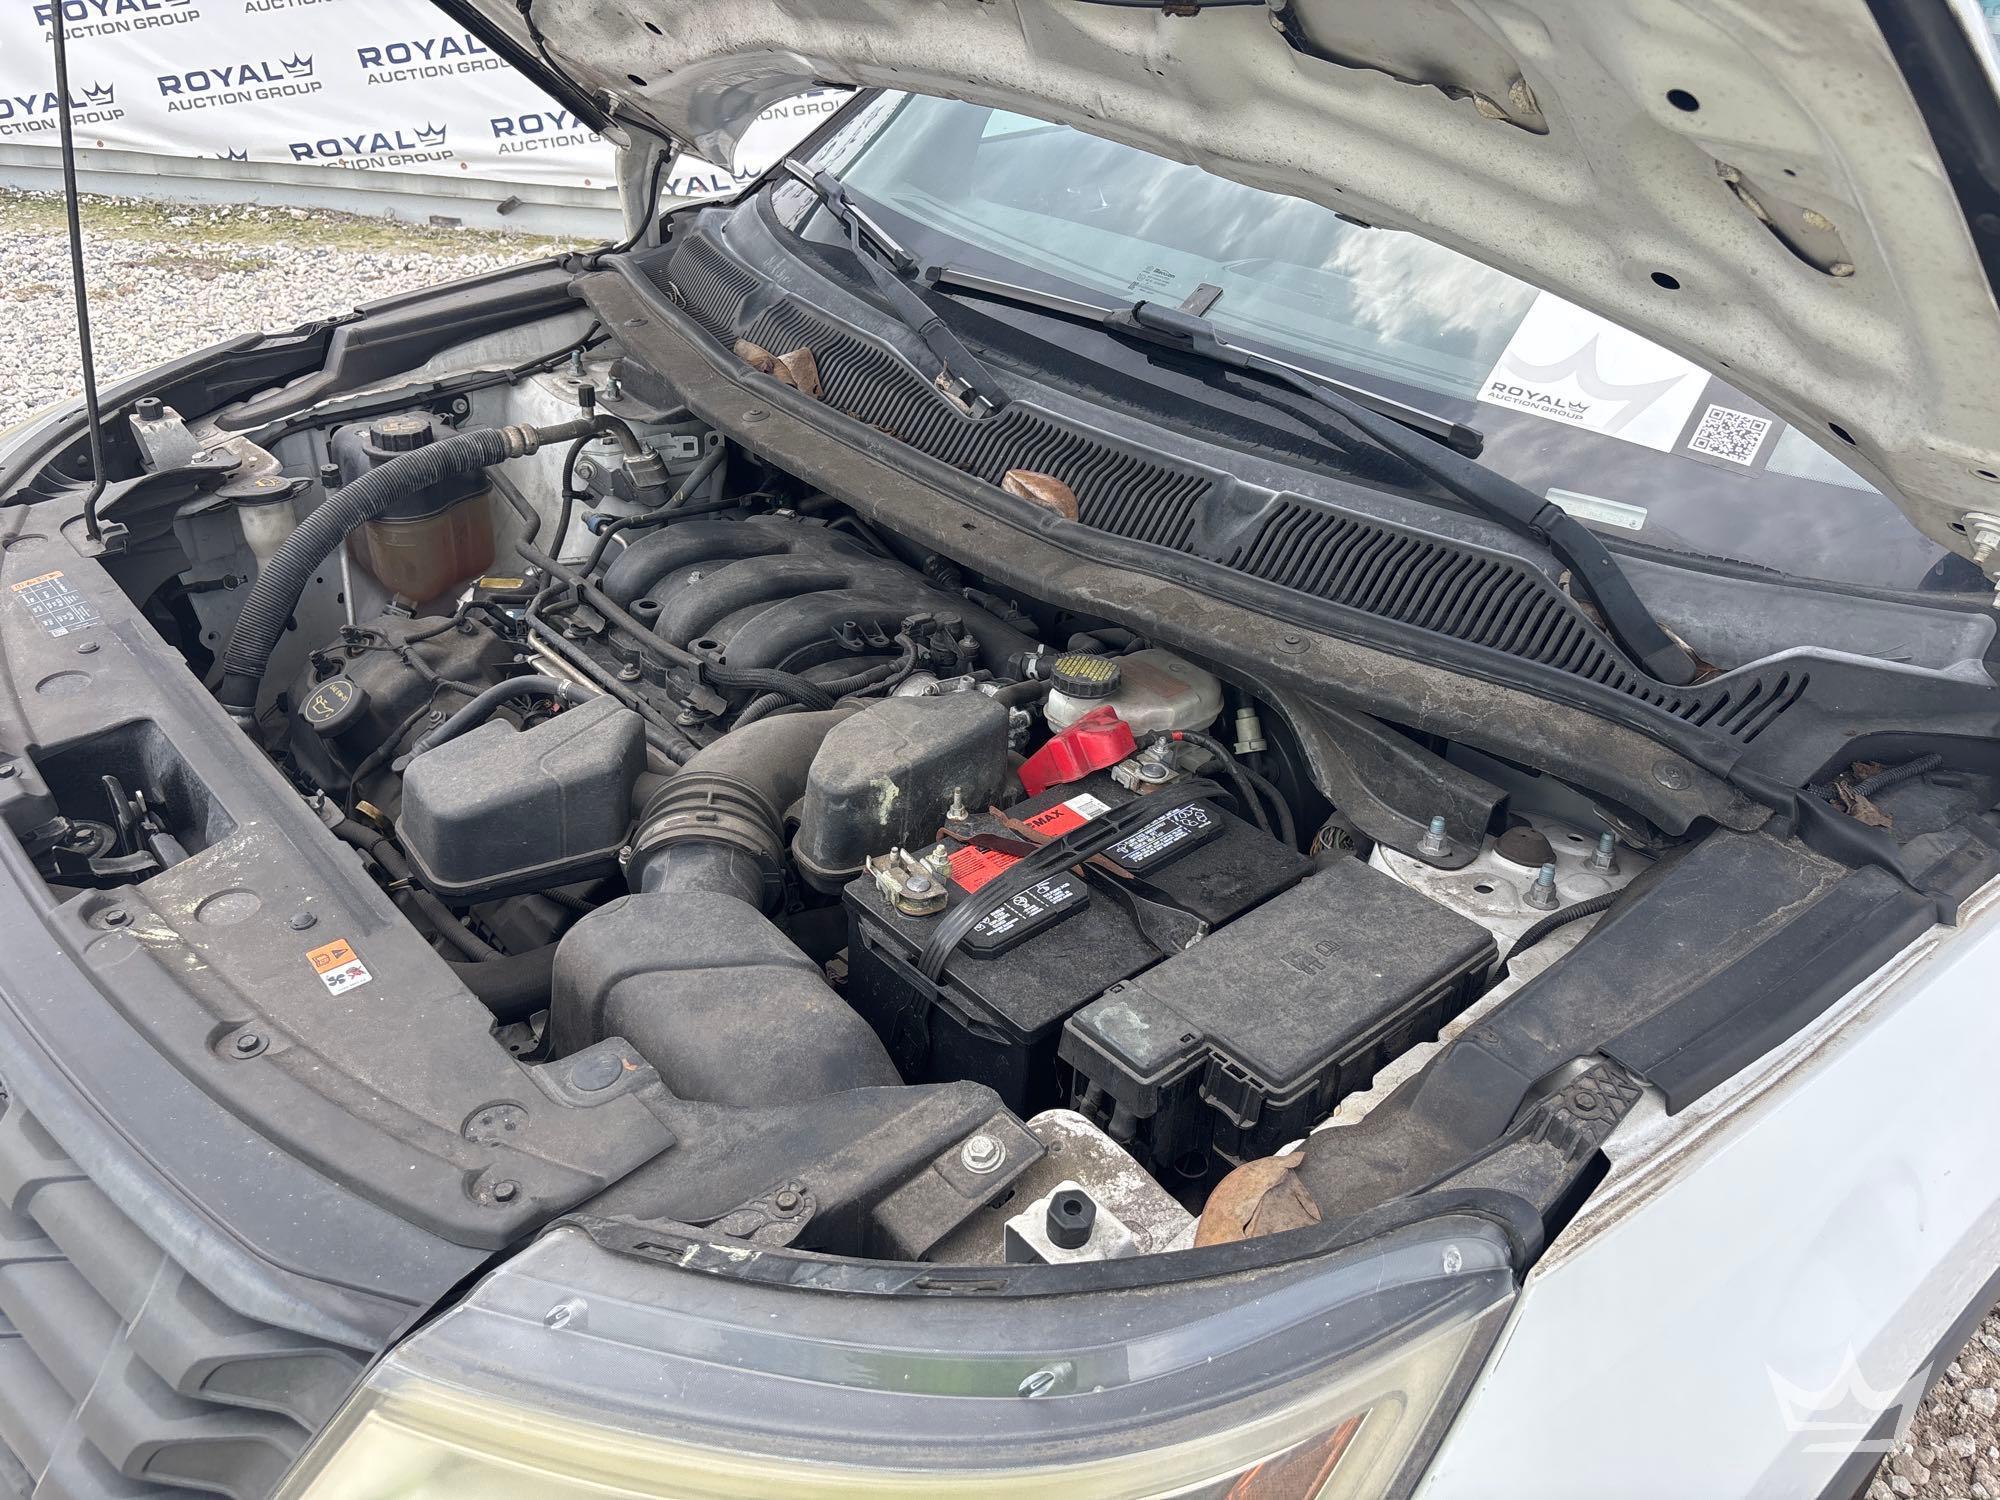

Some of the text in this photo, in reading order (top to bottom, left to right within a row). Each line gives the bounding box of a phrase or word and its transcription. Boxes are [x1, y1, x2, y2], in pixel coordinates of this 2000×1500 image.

[134, 10, 200, 30] GROUP
[357, 34, 487, 69] ROYAL
[157, 62, 284, 96] ROYAL
[367, 58, 511, 85] AUCTION GROU
[0, 90, 88, 119] OYAL
[167, 81, 322, 112] AUCTION GROUP
[793, 100, 840, 116] GRO
[0, 109, 125, 135] CTION ROUP
[490, 110, 582, 138] ROY
[288, 130, 416, 161] ROYAL
[498, 135, 584, 155] AUCTION
[388, 150, 454, 167] GROUP
[666, 174, 731, 195] YAL
[1488, 392, 1584, 420] AUCTION GROUP
[1491, 382, 1566, 408] ROYAL
[1026, 809, 1064, 828] MAX
